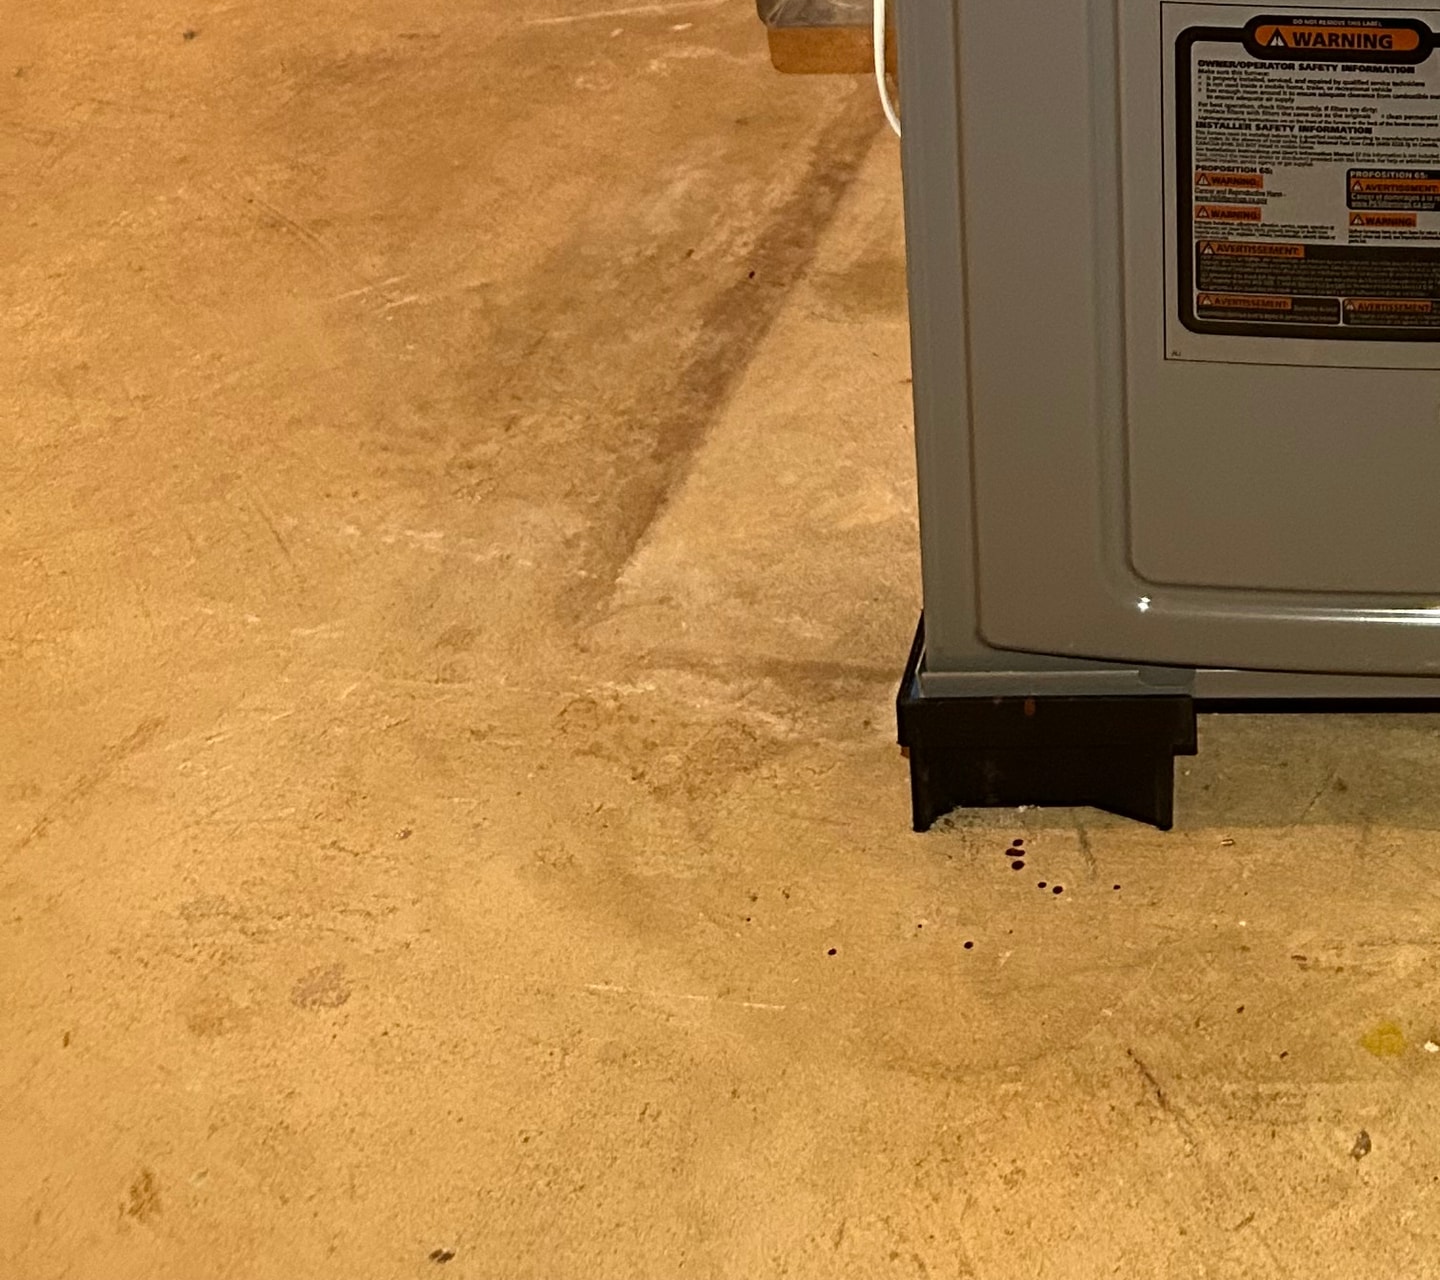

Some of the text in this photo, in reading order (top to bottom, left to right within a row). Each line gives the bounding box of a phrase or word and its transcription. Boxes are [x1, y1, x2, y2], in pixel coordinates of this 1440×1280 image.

[1292, 31, 1393, 50] WARNING
[1198, 59, 1415, 74] OWNER/OPERATOR SAFETY INFORMATION
[1196, 121, 1252, 131] INSTALLER
[1255, 123, 1295, 132] SAFETY
[1298, 125, 1372, 134] INFORMATION
